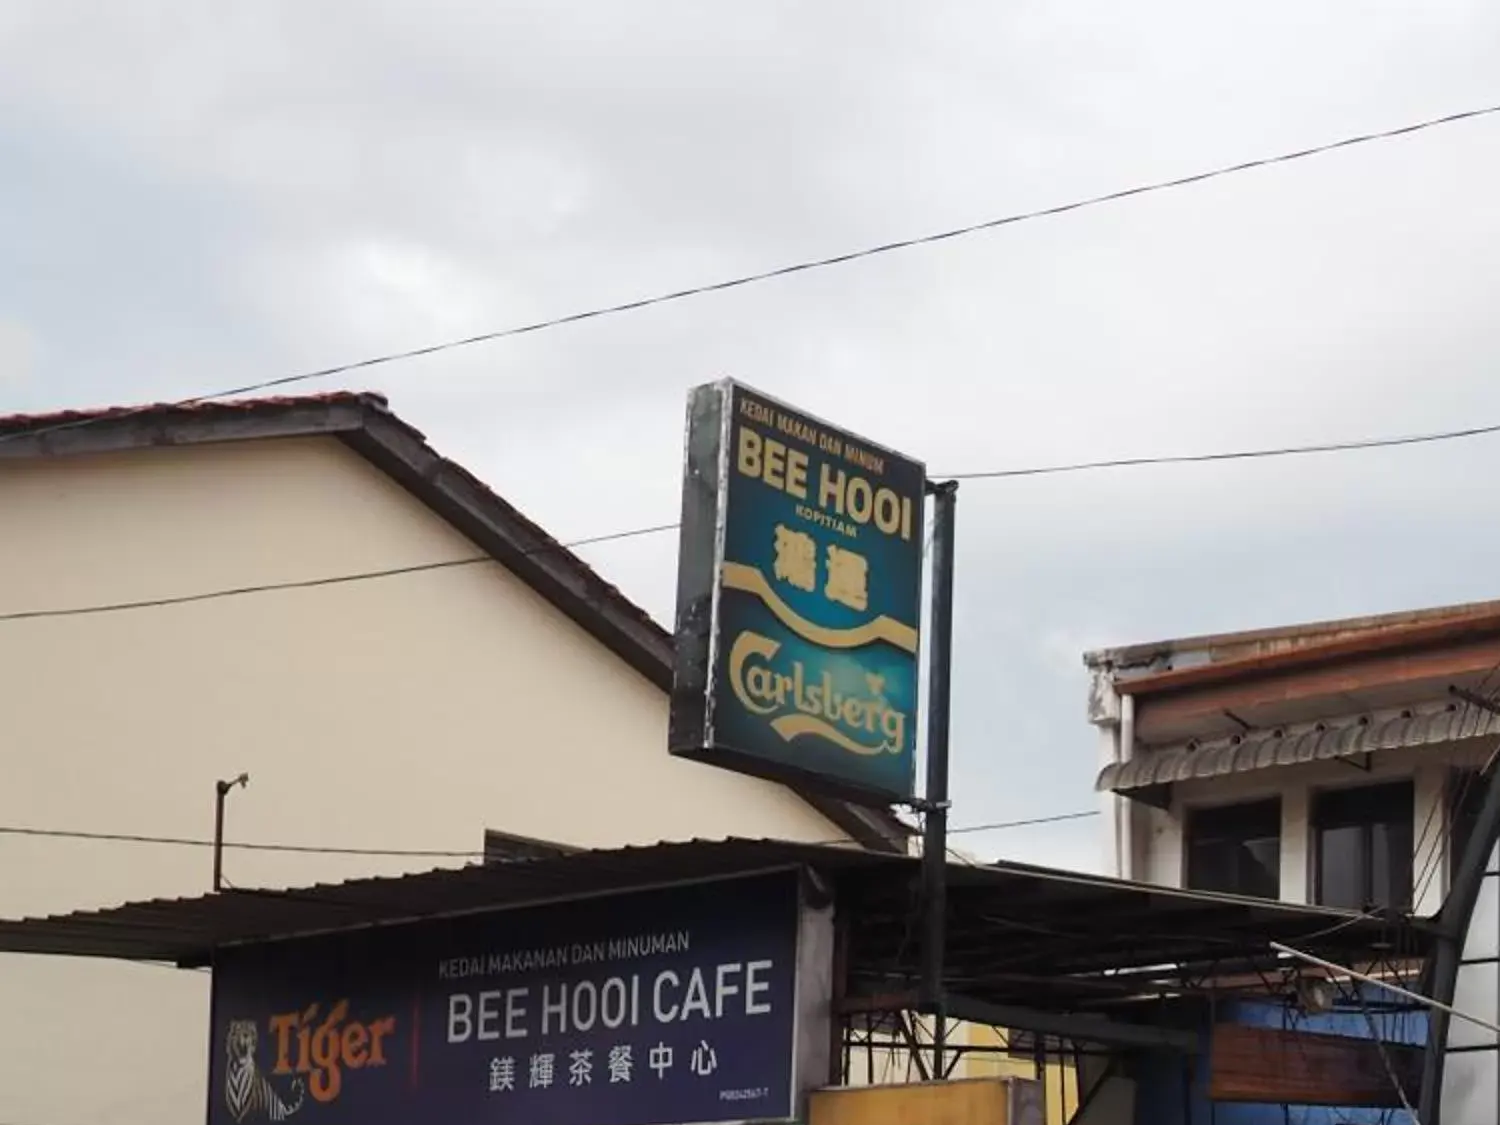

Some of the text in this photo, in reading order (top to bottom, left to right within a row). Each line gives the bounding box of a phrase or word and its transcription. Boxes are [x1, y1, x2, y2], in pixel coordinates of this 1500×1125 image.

[740, 397, 884, 475] KEDAI MAKAN DAN MINUM
[738, 425, 912, 540] BEE HOOI
[796, 504, 857, 538] KOPITIAM
[729, 630, 906, 753] Carlsberg
[438, 930, 690, 980] KEDAI MAKANAN DAN MINUMAN
[447, 960, 773, 1043] BEE HOOI CAFE
[269, 1000, 396, 1103] Tiger
